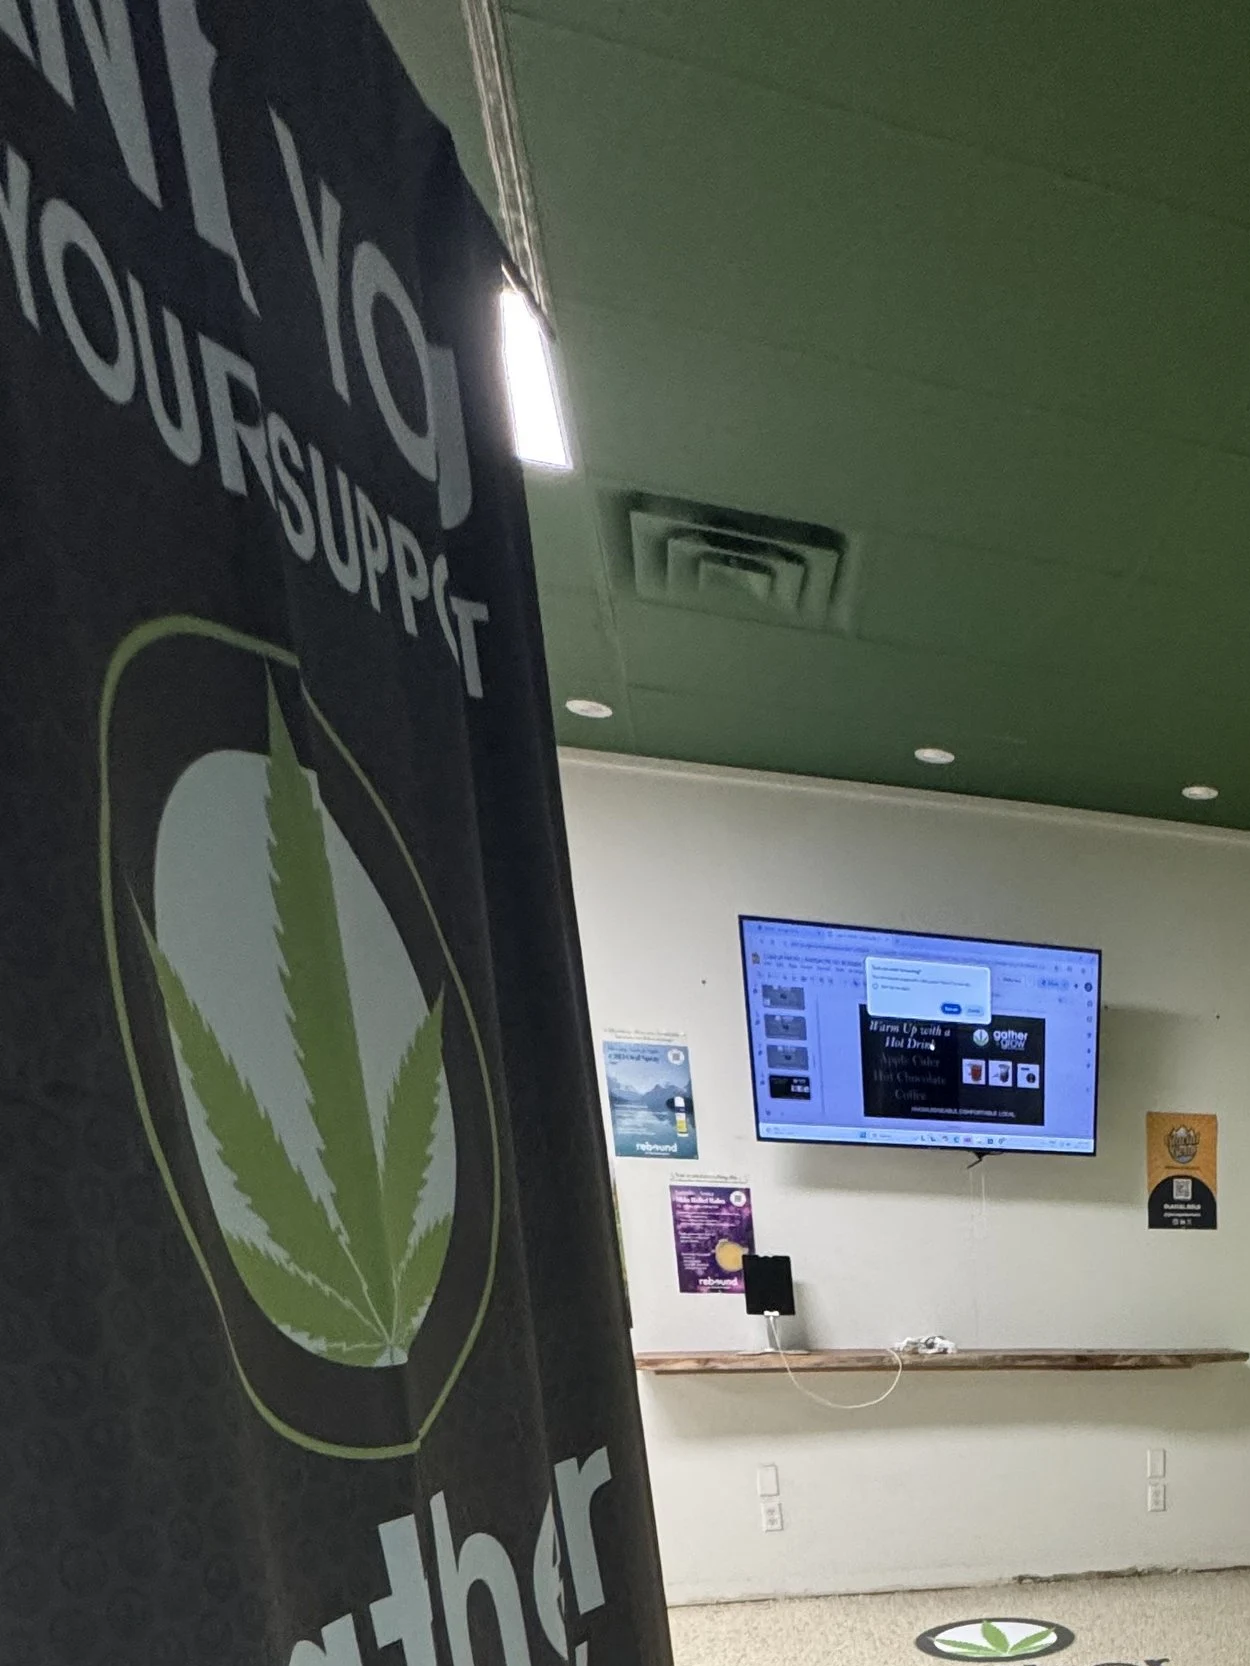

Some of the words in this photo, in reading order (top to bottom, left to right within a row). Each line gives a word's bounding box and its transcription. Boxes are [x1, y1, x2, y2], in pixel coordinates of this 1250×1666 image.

[0, 145, 278, 513] YOUR
[267, 411, 489, 699] SUPPT
[869, 1019, 900, 1034] Warm
[903, 1022, 918, 1038] Up
[919, 1023, 942, 1037] with
[944, 1028, 951, 1038] a
[885, 1035, 905, 1048] Hot
